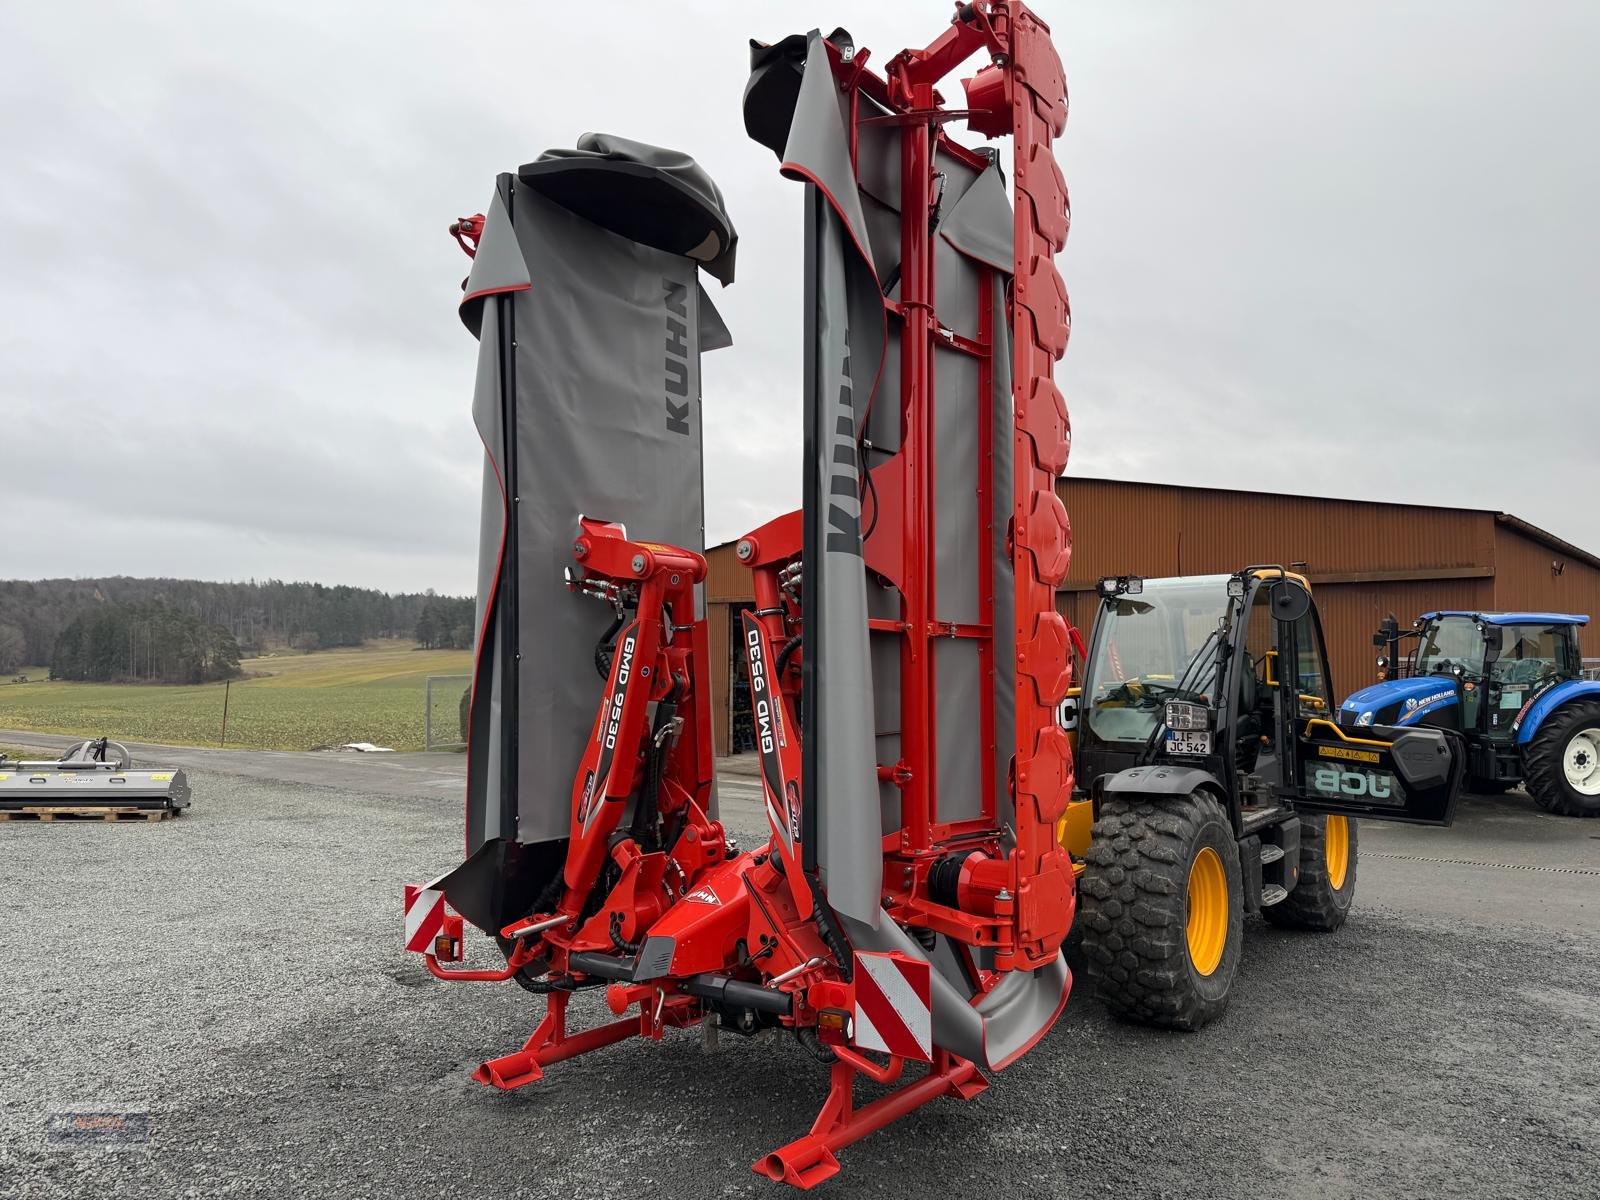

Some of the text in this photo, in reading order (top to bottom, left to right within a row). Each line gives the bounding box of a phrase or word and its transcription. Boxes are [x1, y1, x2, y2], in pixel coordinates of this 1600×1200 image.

[662, 276, 690, 436] KUHN
[605, 636, 636, 750] GMD 9530
[747, 629, 774, 755] GMD 9530
[1418, 689, 1456, 706] NEW HOLLAND
[1170, 742, 1206, 753] JC 542
[1173, 732, 1193, 742] LIF
